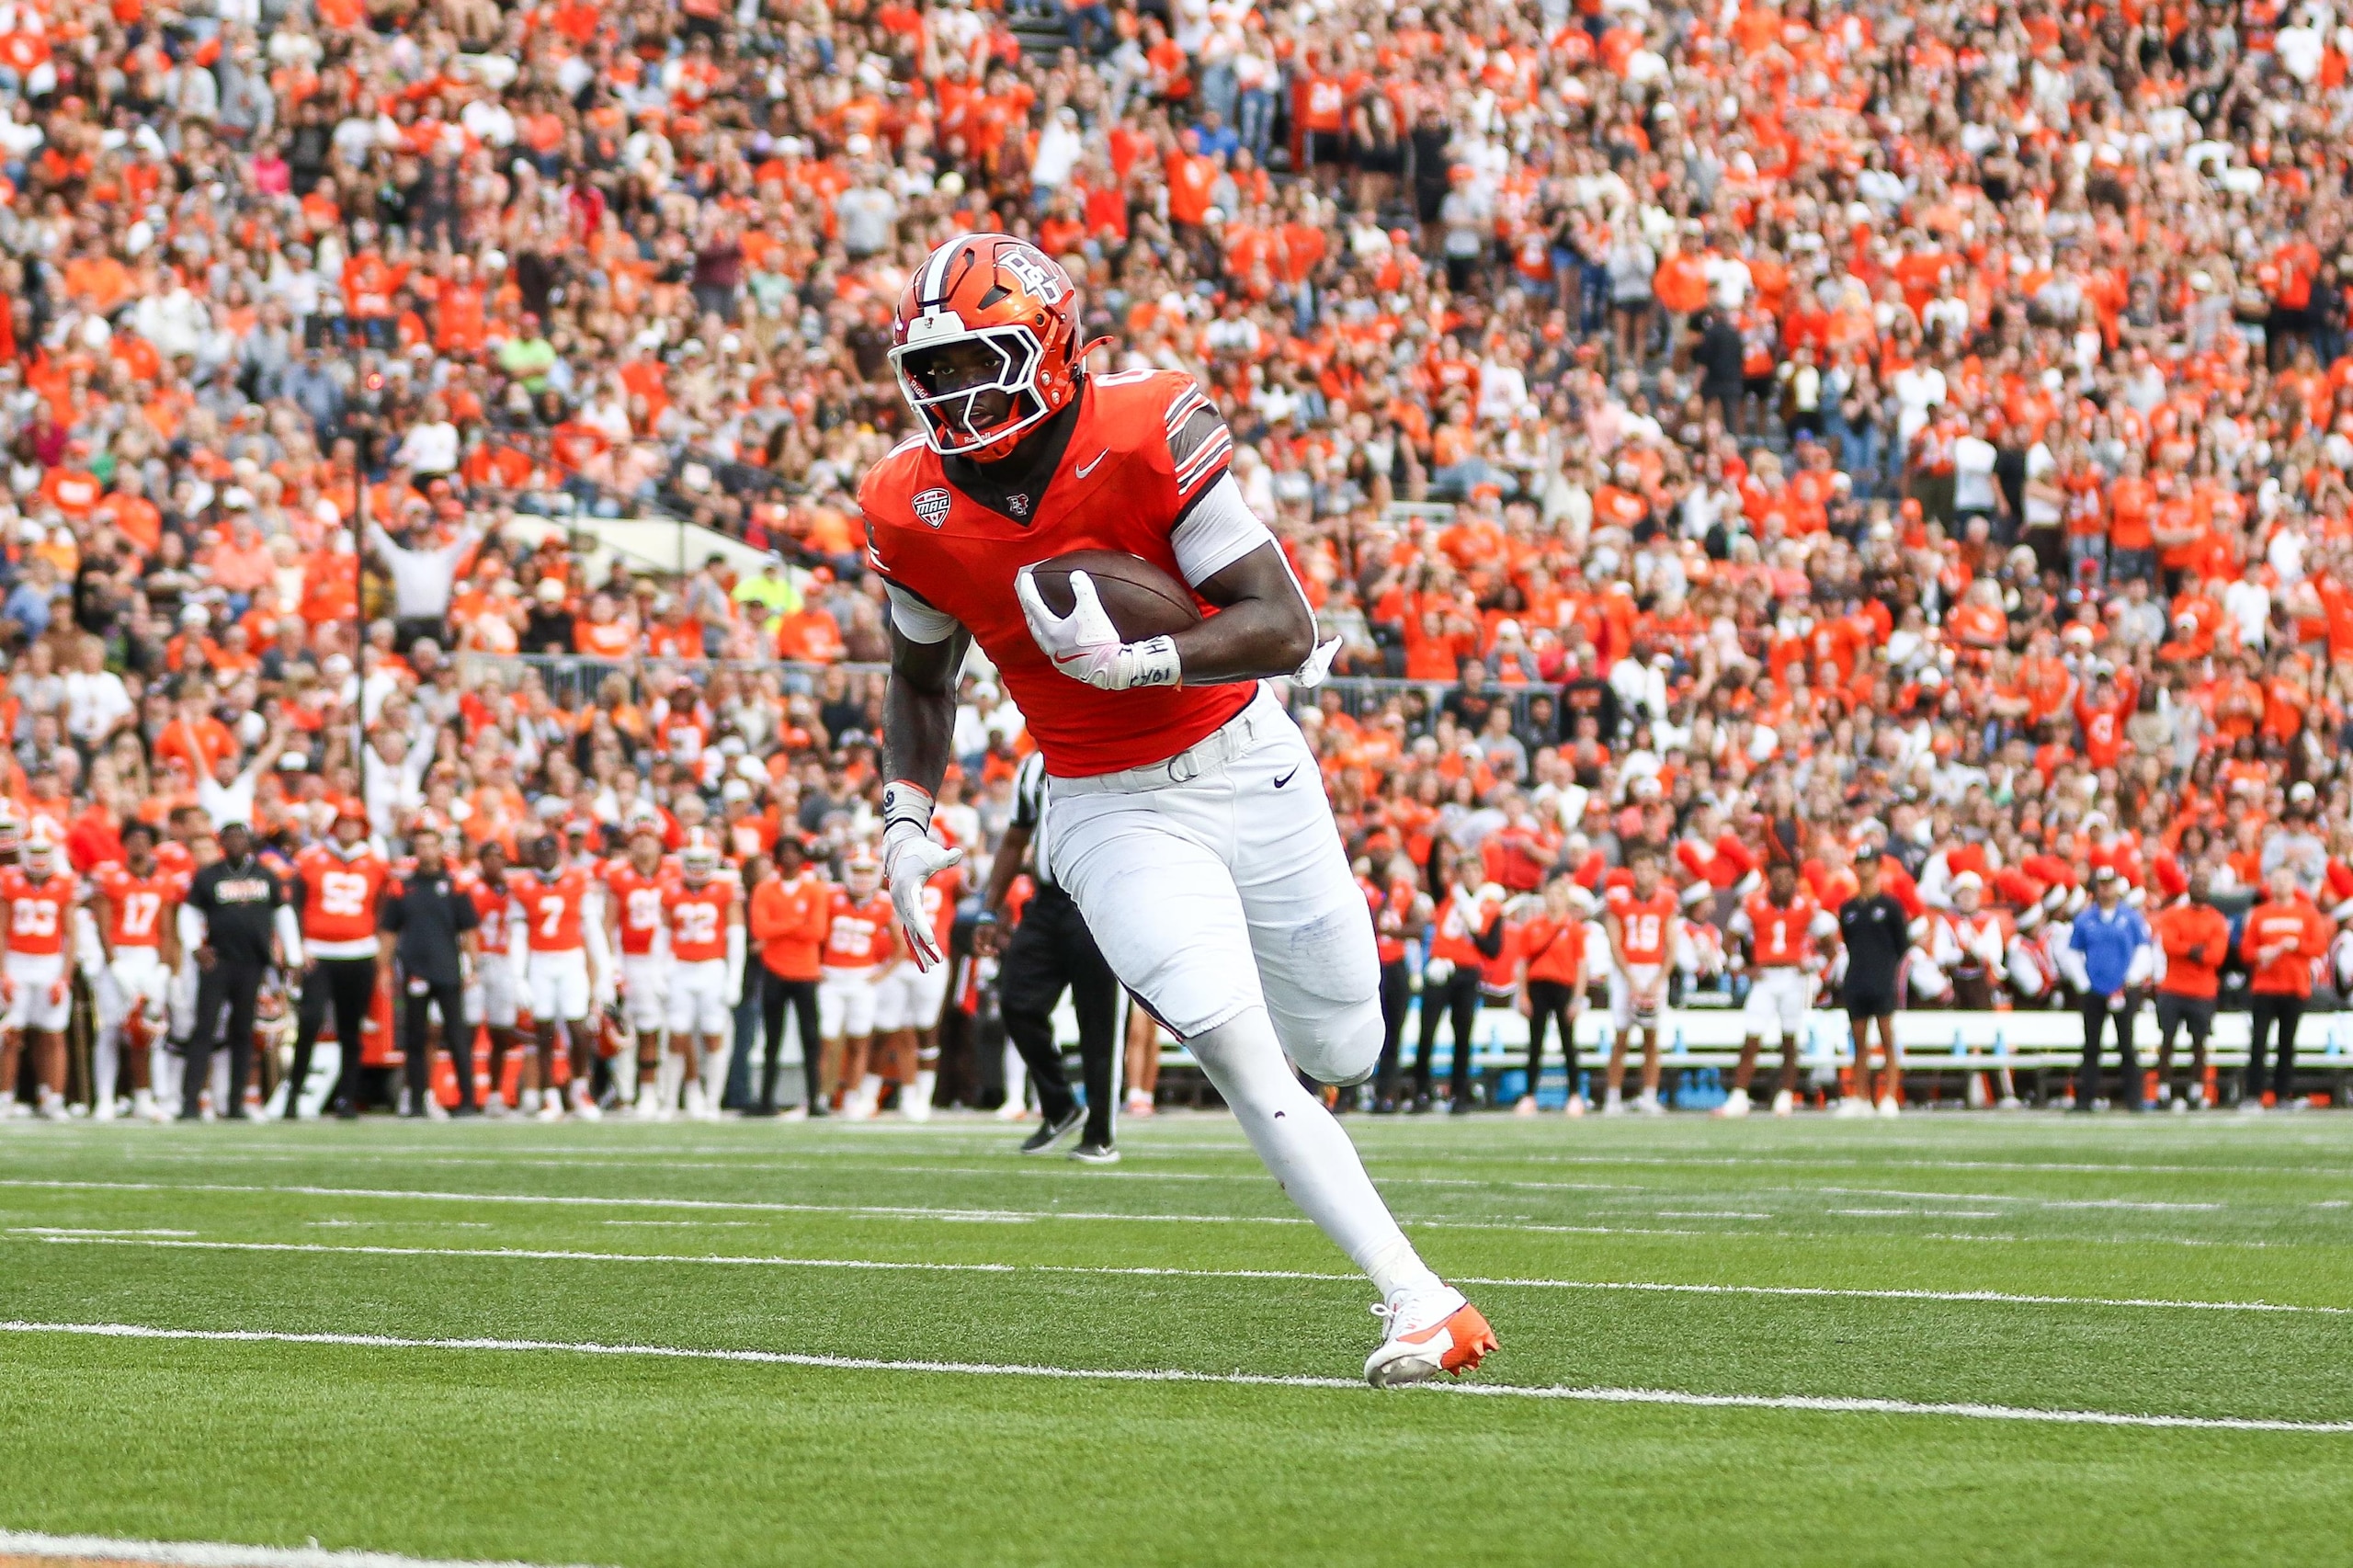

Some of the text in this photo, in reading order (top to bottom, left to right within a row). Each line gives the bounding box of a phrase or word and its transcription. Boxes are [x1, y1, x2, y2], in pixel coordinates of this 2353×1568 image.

[915, 498, 950, 516] MAC
[122, 892, 161, 936] 17
[538, 895, 565, 937] 7
[1771, 920, 1788, 956] 1
